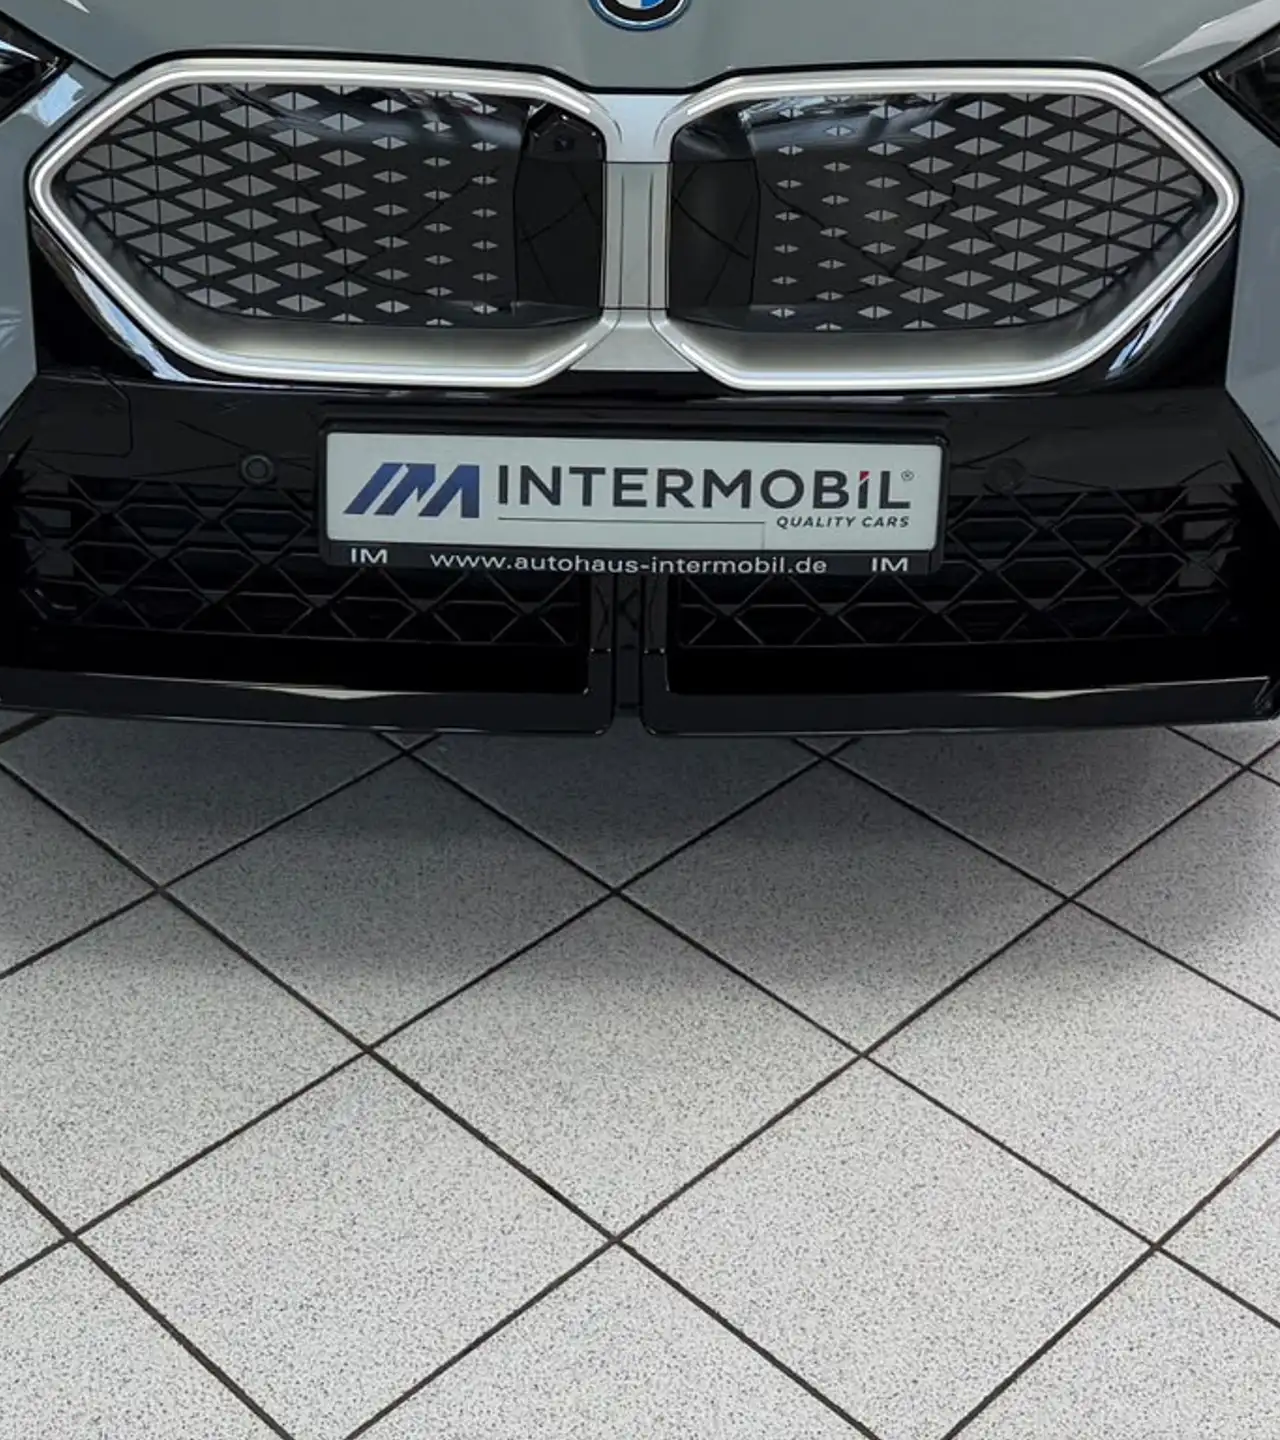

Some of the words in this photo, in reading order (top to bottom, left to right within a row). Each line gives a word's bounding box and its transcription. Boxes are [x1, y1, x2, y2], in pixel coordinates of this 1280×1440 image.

[776, 516, 855, 529] QUALITY
[861, 516, 910, 528] CARS
[351, 547, 388, 564] IM
[430, 553, 827, 575] www.autohaus-intermobil.de
[871, 557, 908, 572] IM
